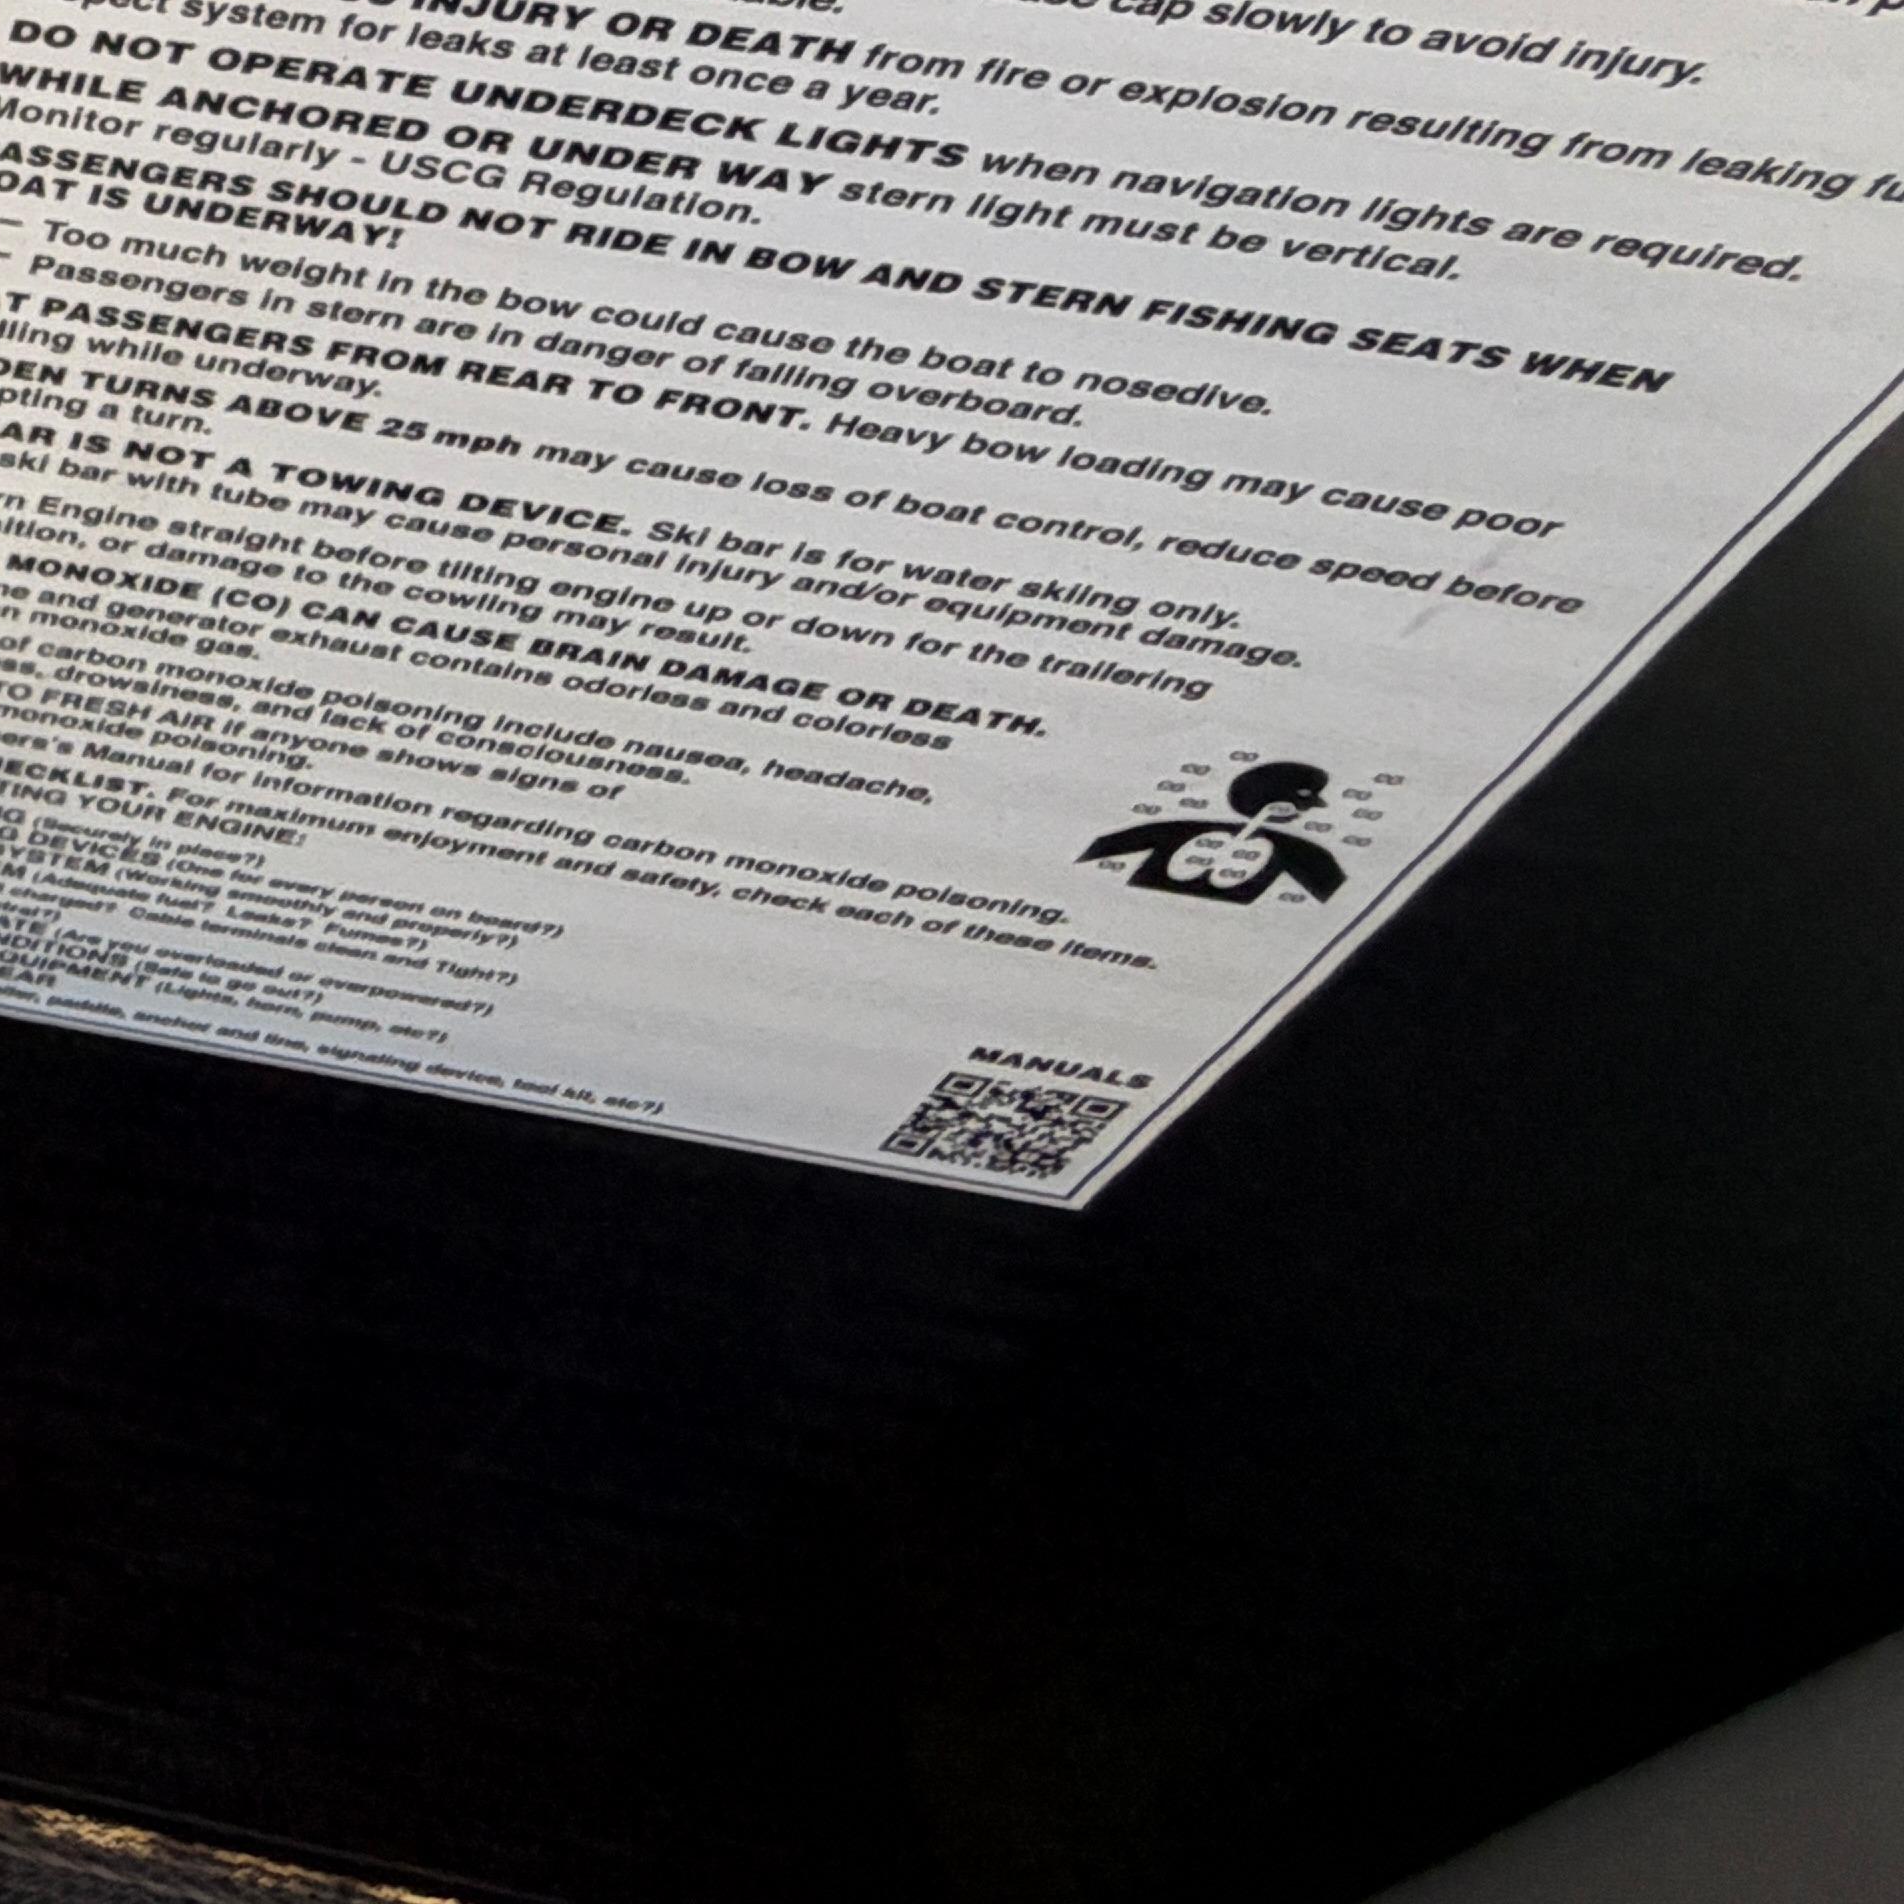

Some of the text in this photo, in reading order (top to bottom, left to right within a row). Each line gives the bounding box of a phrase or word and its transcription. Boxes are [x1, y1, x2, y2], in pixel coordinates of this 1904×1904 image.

[8, 19, 1803, 282] DO NOT OPERATE UNDERDECK LIGHTS when navigation lights are required.
[266, 179, 449, 224] SHOULD
[457, 206, 558, 240] NOT
[563, 221, 675, 257] RIDE
[681, 237, 737, 265] IN
[743, 246, 858, 281] BOW
[859, 262, 964, 294] AND
[971, 276, 1134, 318] STERN
[1139, 298, 1340, 346] FISHING
[1347, 327, 1512, 370] SEATS
[1519, 350, 1676, 394] WHEN
[5, 553, 204, 601] MONOXIDE
[211, 586, 292, 619] (CO)
[300, 600, 382, 630] CAN
[390, 615, 521, 652] CAUSE
[526, 637, 652, 673] BRAIN
[657, 658, 830, 702] DAMAGE
[835, 687, 896, 712] OR
[900, 697, 1047, 738] DEATH.
[967, 1045, 1154, 1090] MANUALS
